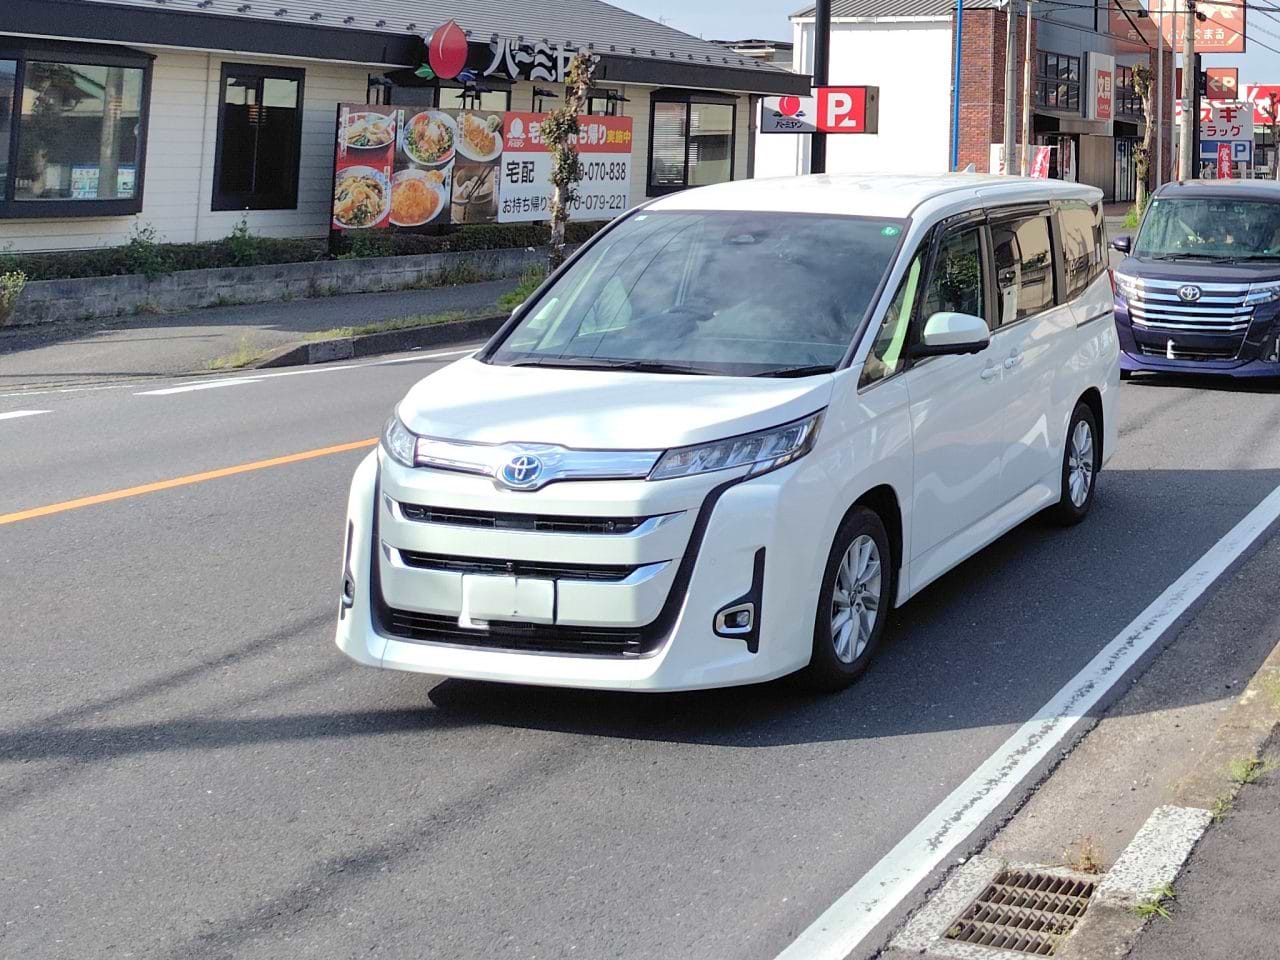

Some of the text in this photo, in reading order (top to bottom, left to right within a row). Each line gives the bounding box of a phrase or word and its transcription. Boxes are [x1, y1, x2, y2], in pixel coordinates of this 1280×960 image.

[826, 92, 853, 127] P
[1235, 144, 1246, 158] P
[506, 160, 535, 183] 宅配
[502, 195, 626, 213] お持ち帰り 70-079-221
